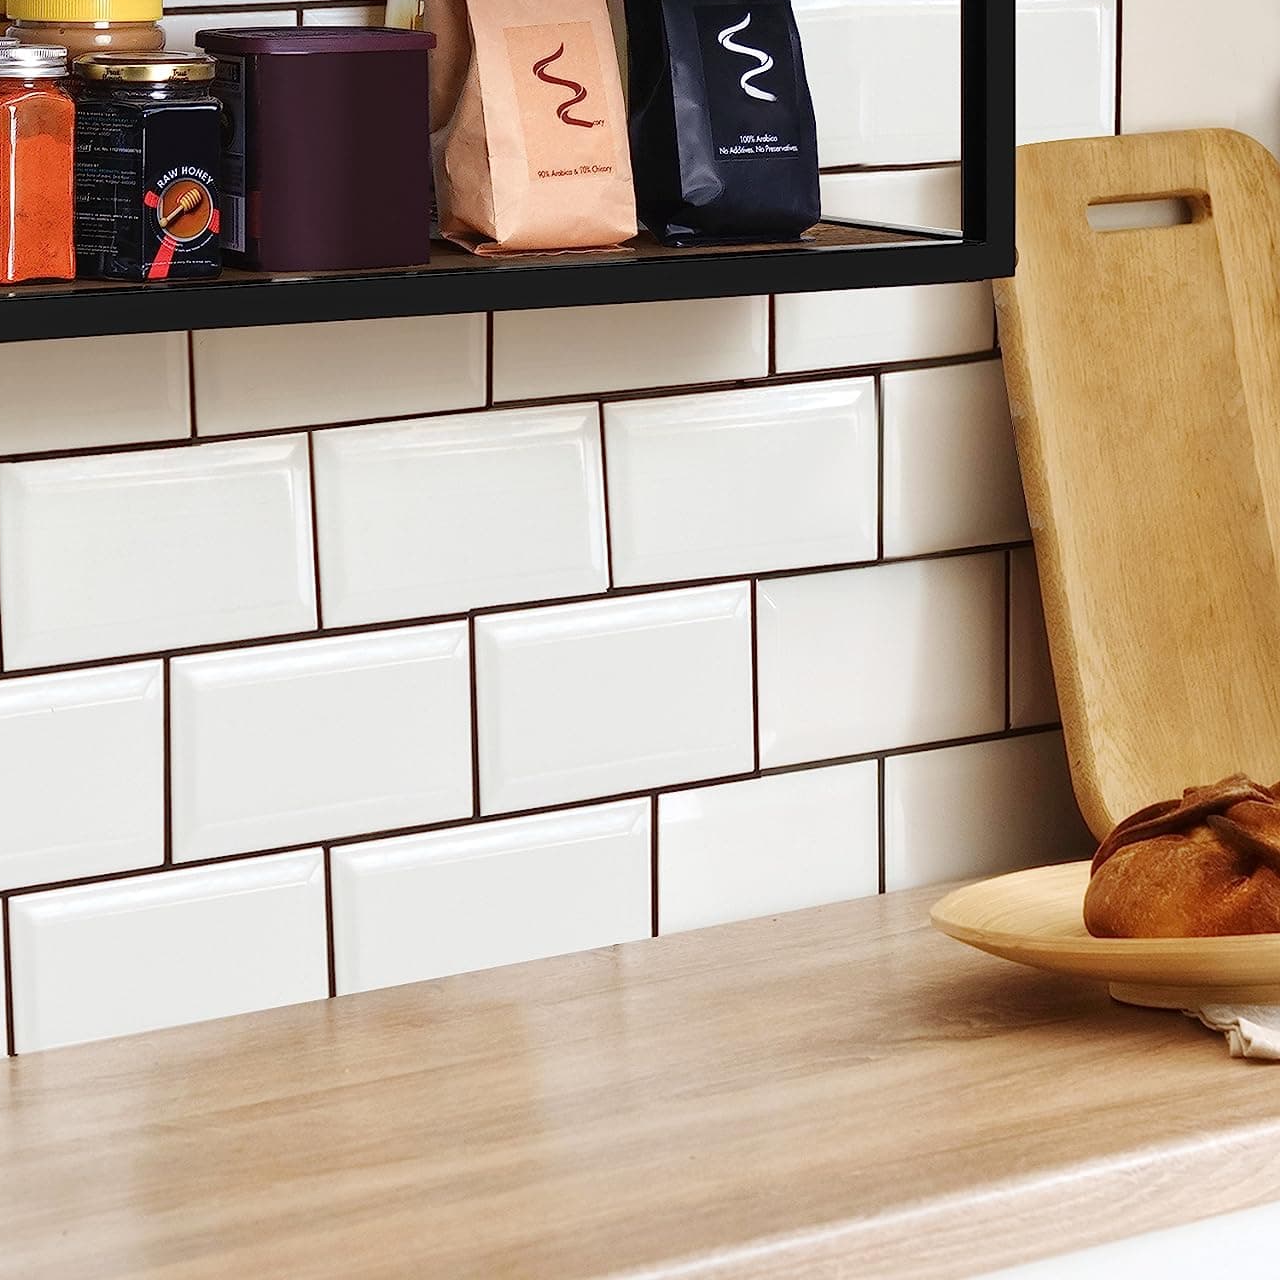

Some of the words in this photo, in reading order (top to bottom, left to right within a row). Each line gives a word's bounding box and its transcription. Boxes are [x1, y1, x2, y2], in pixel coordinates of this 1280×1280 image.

[739, 134, 755, 144] 100%
[756, 133, 778, 143] Arabica
[719, 146, 729, 155] No
[755, 145, 765, 153] No
[156, 167, 178, 189] RAW
[181, 165, 214, 185] HONEY
